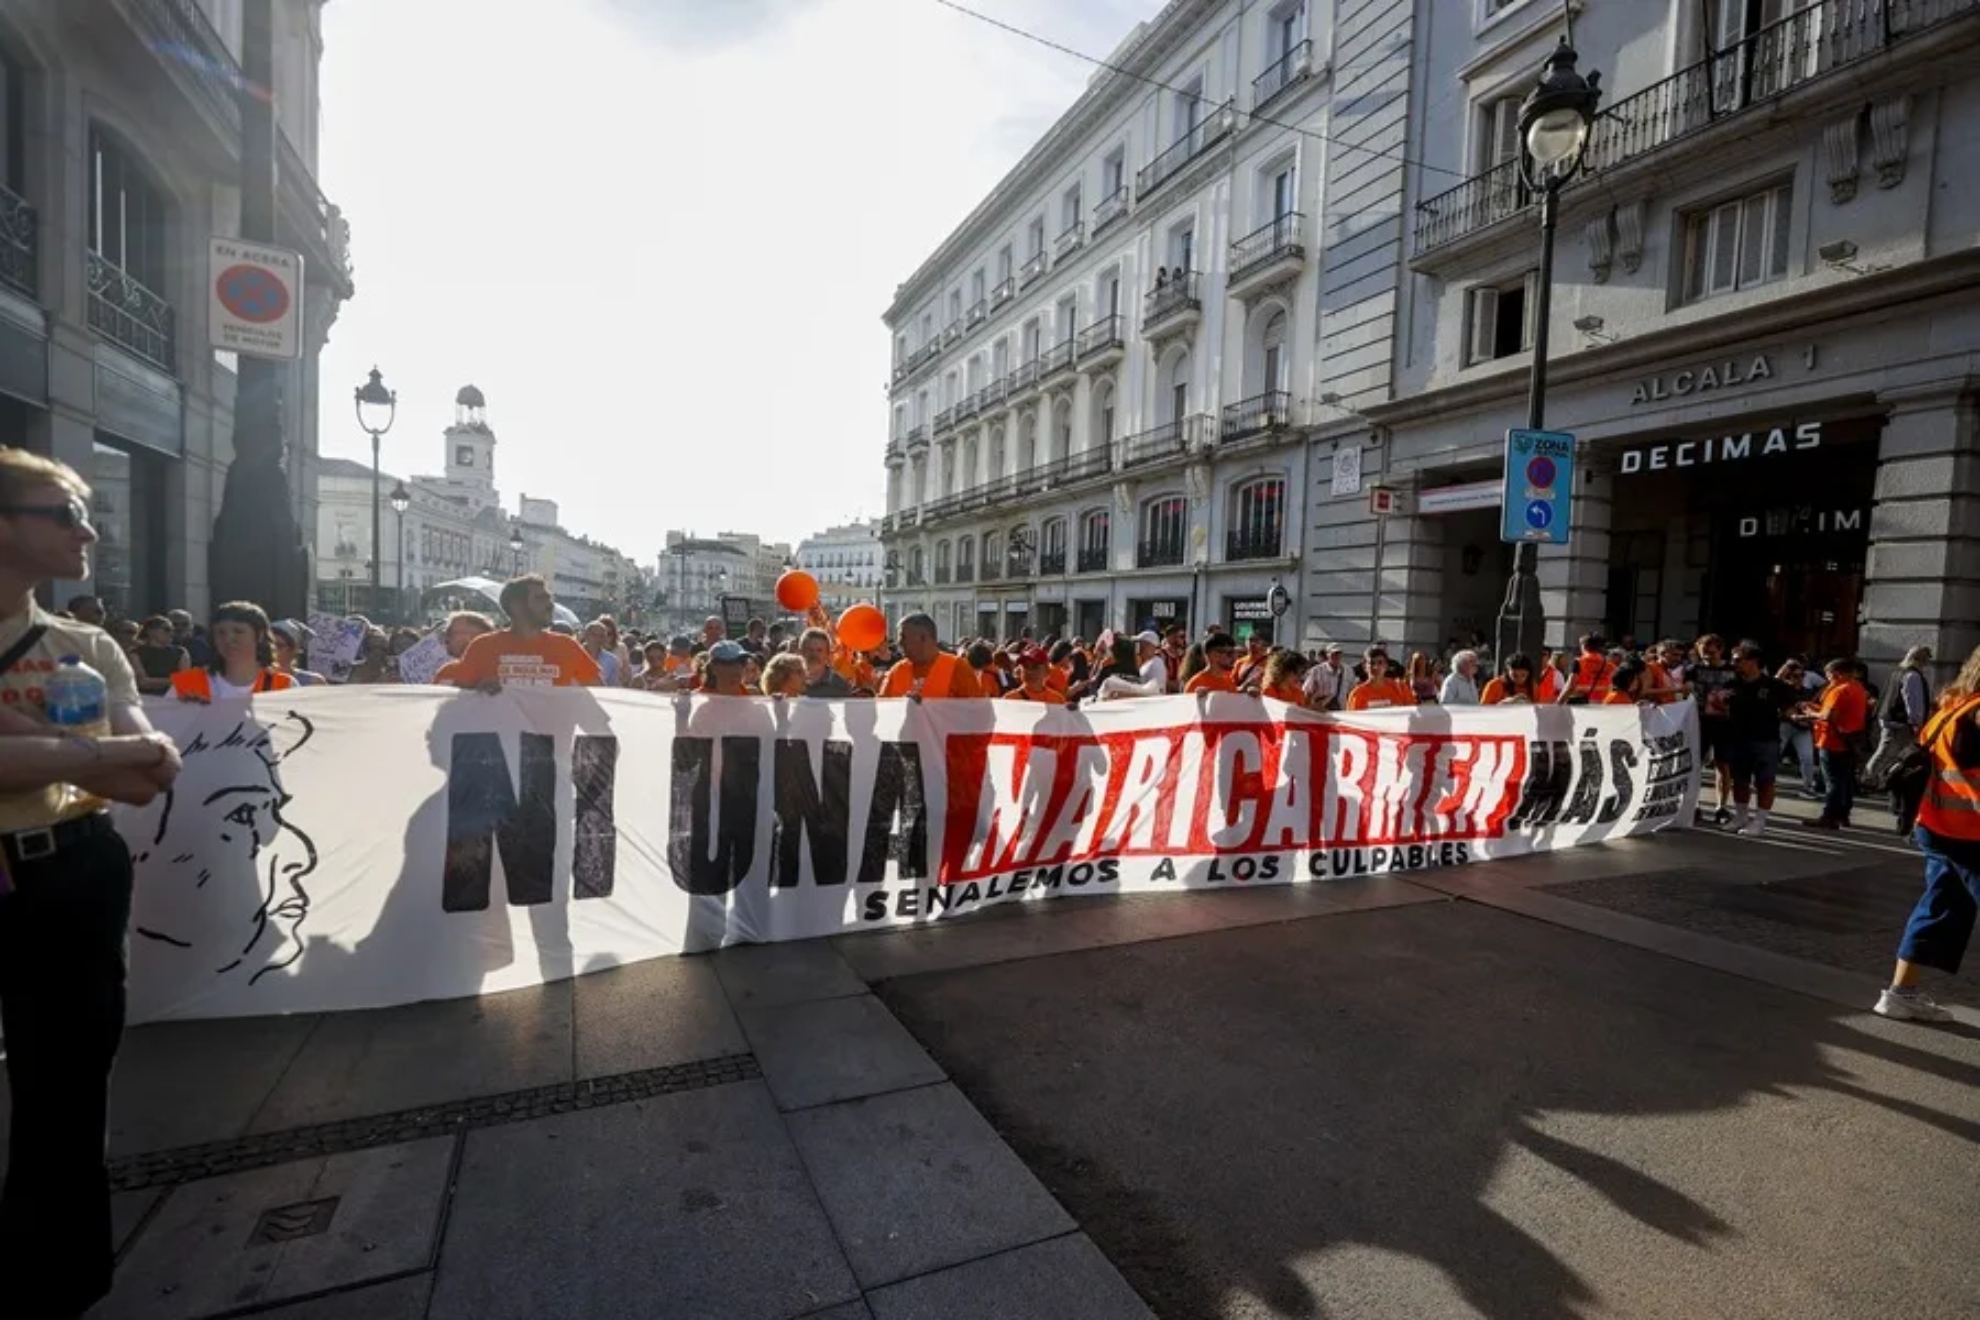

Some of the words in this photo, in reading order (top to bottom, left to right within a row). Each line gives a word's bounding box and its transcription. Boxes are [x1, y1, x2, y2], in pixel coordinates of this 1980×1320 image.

[216, 245, 236, 257] EN
[242, 250, 290, 268] ACERA
[1631, 355, 1771, 404] ALCALA
[1803, 344, 1815, 369] 1
[1534, 438, 1569, 453] ZONA
[1621, 422, 1822, 474] DECIMAS
[442, 731, 617, 913] NI
[667, 735, 928, 896] UNA
[961, 729, 1517, 871] MARICARMEN
[1508, 727, 1638, 830] MÁS
[1150, 857, 1176, 881] A
[1207, 856, 1279, 881] LOS
[1308, 842, 1469, 877] CULPABLES
